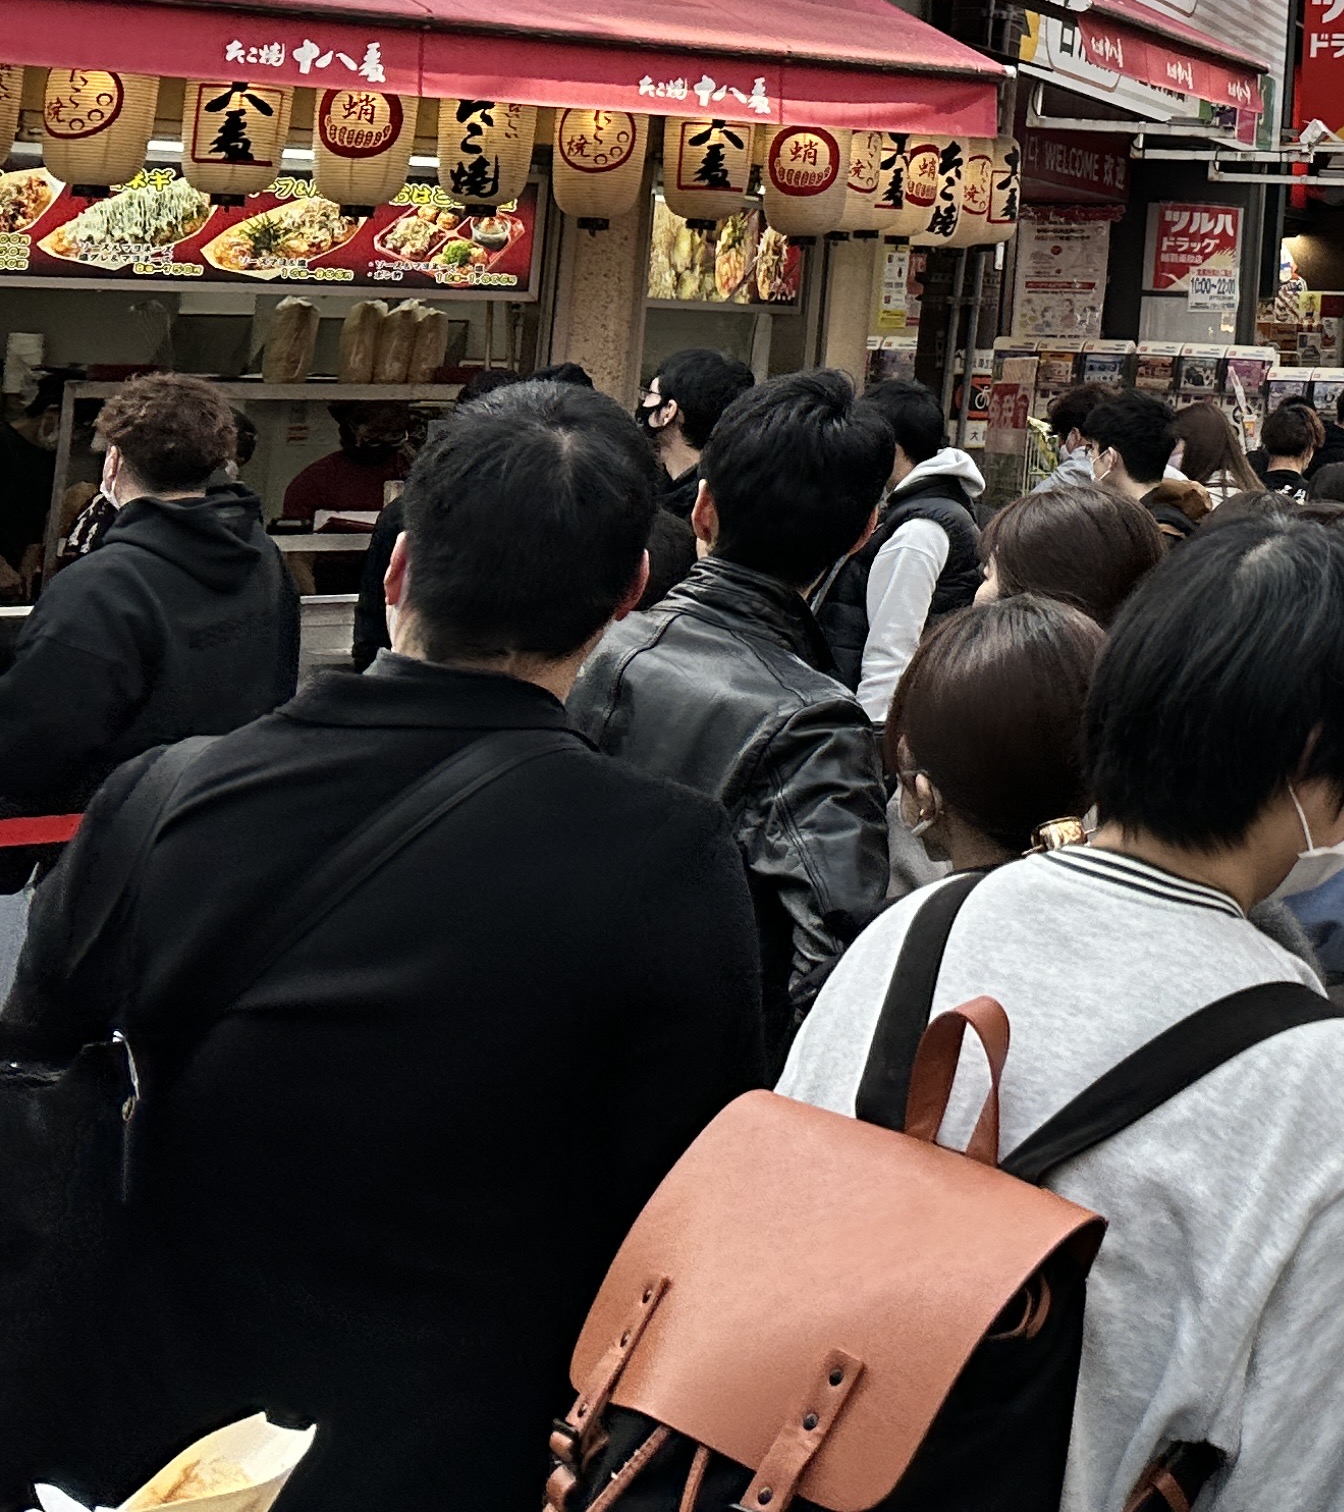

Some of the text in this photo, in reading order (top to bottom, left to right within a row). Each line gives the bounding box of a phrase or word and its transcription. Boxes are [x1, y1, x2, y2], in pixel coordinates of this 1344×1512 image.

[342, 94, 377, 125] 蛸
[789, 140, 818, 167] 蛸
[1043, 141, 1100, 181] WELCOME
[1164, 210, 1235, 237] ツルハ
